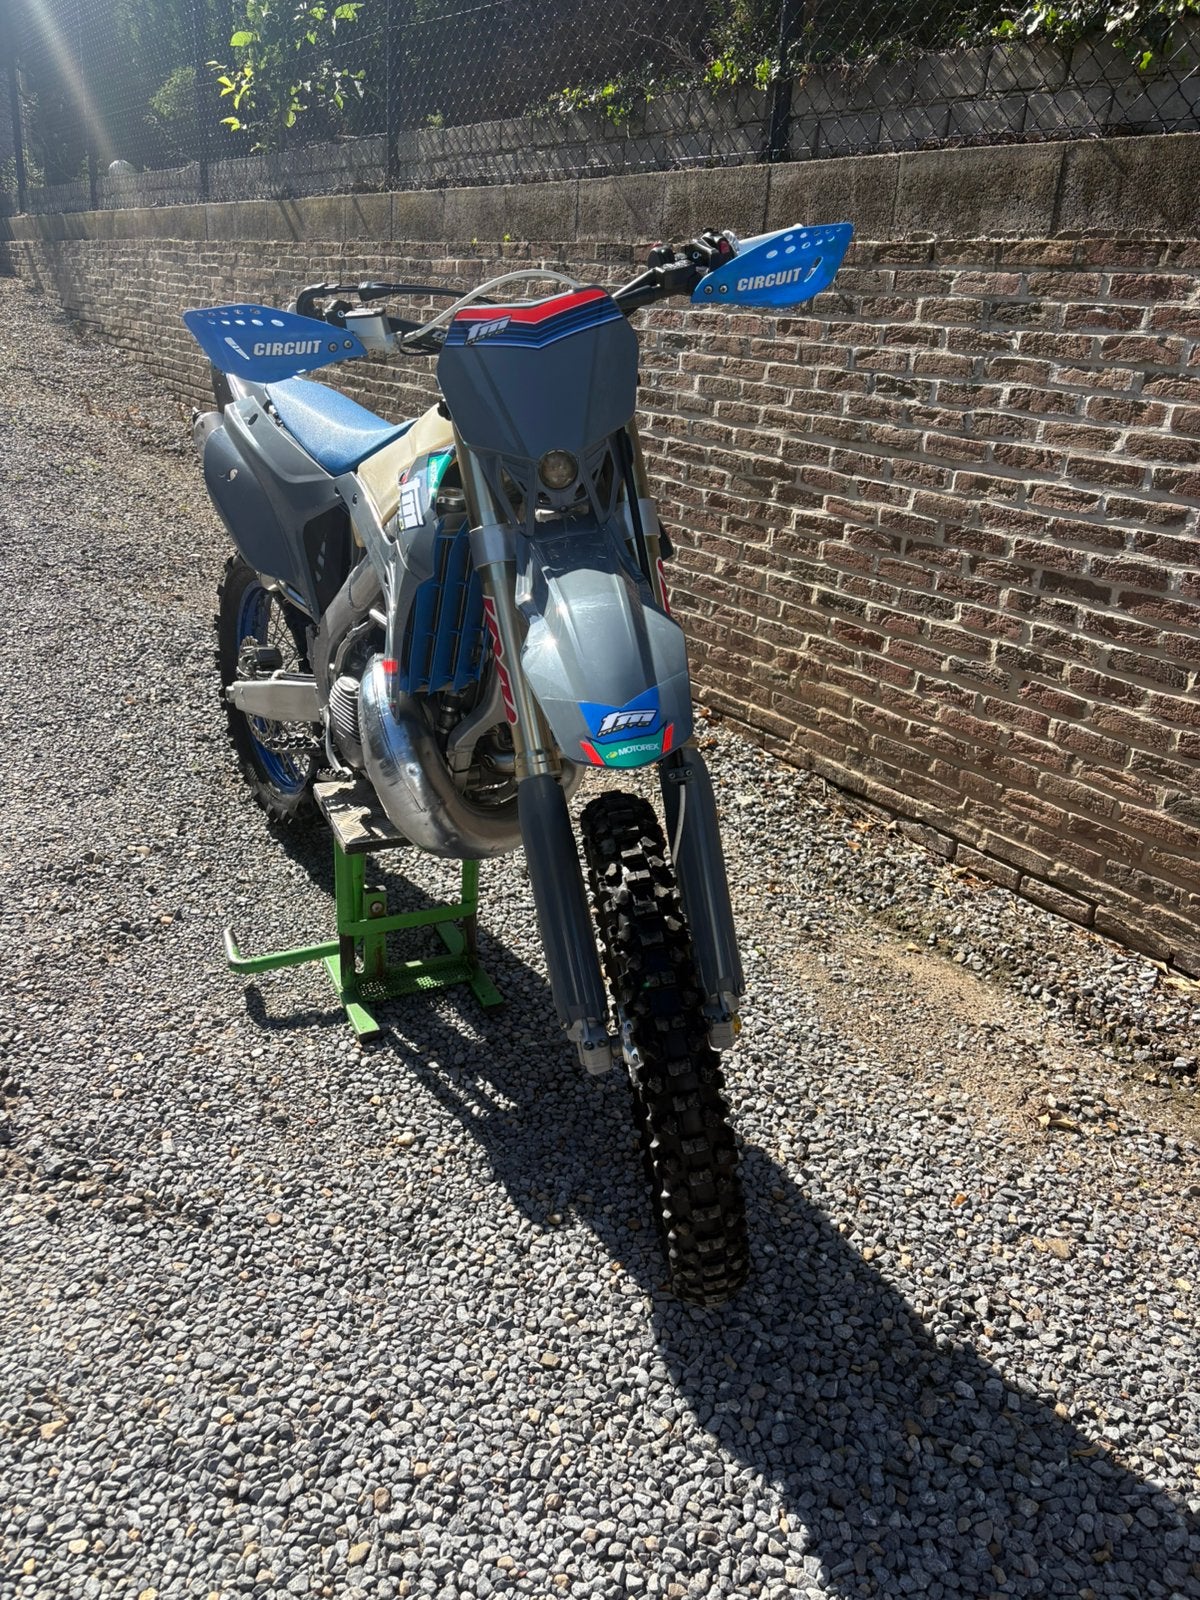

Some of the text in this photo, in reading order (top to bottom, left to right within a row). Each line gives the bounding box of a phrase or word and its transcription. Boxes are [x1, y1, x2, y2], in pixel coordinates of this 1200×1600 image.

[737, 268, 802, 291] CIRCUIT
[253, 340, 322, 356] CIRCUIT
[618, 743, 660, 756] MOTOREX
